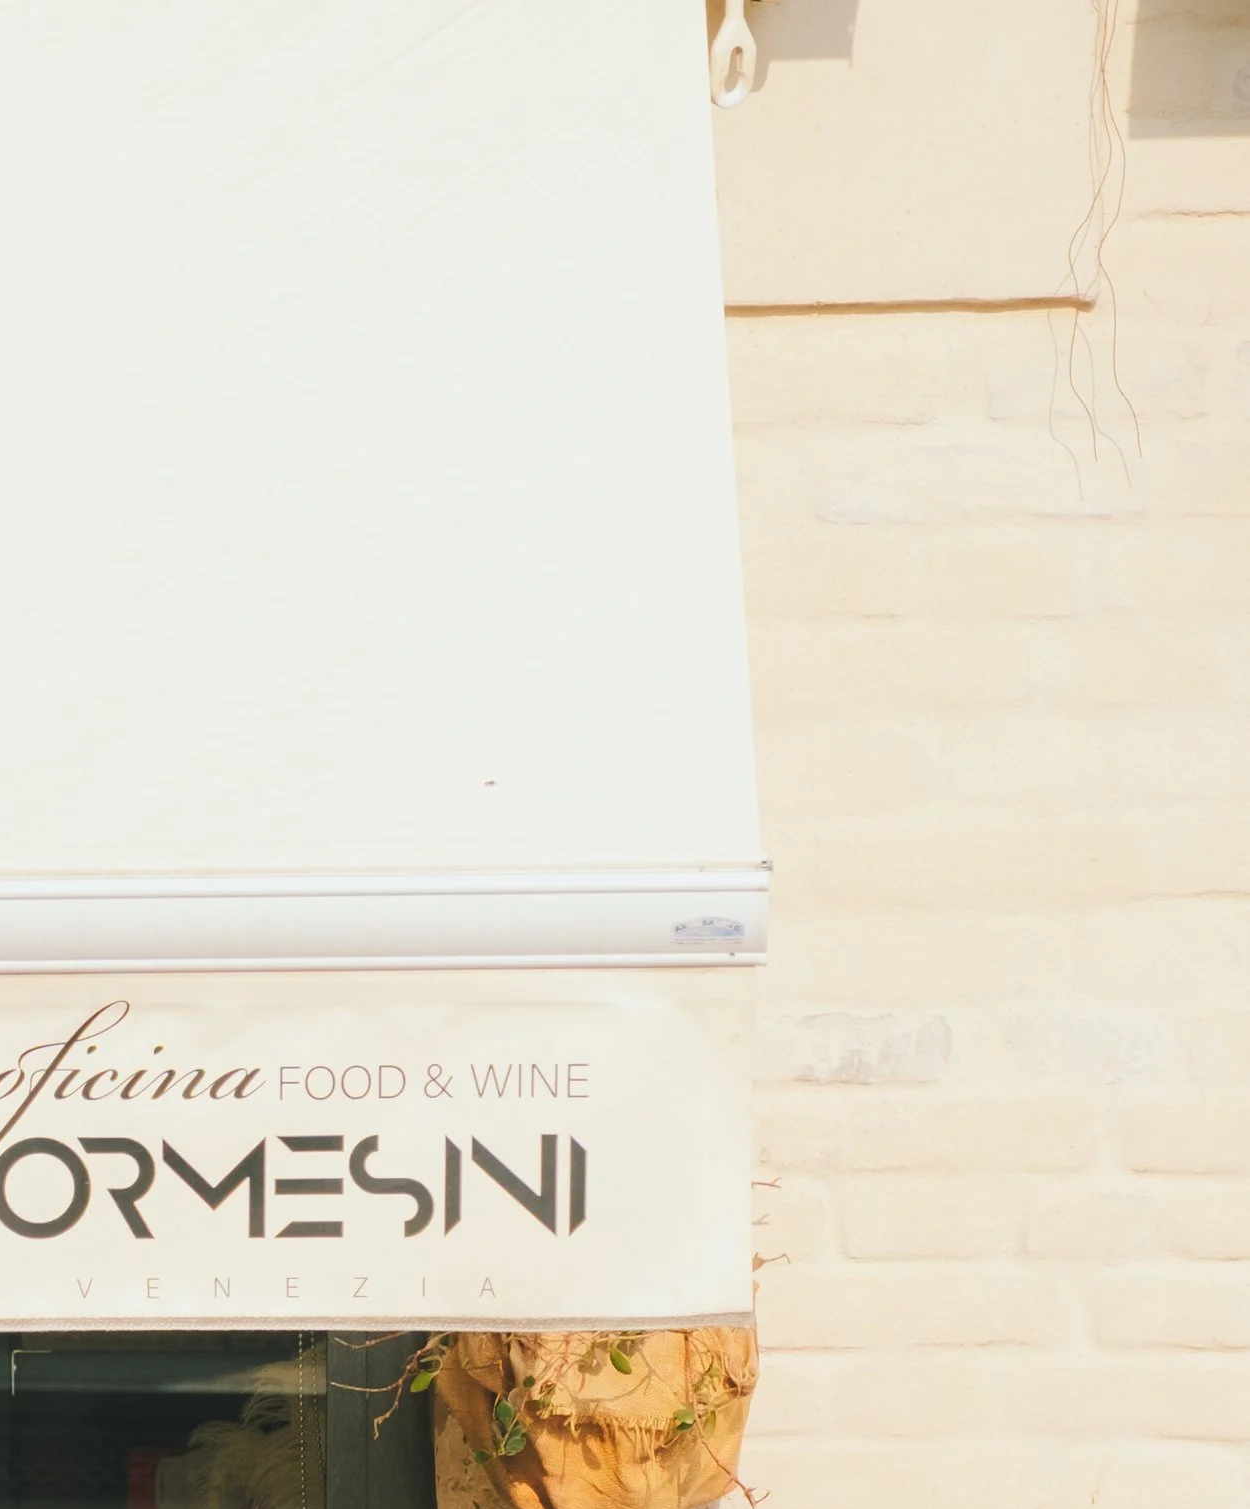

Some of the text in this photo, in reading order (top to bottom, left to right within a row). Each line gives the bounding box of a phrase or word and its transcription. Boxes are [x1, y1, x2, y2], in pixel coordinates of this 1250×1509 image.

[280, 1065, 406, 1100] FOOD
[424, 1064, 453, 1098] &
[471, 1064, 589, 1098] WINE
[77, 1277, 495, 1298] VENEZIA
